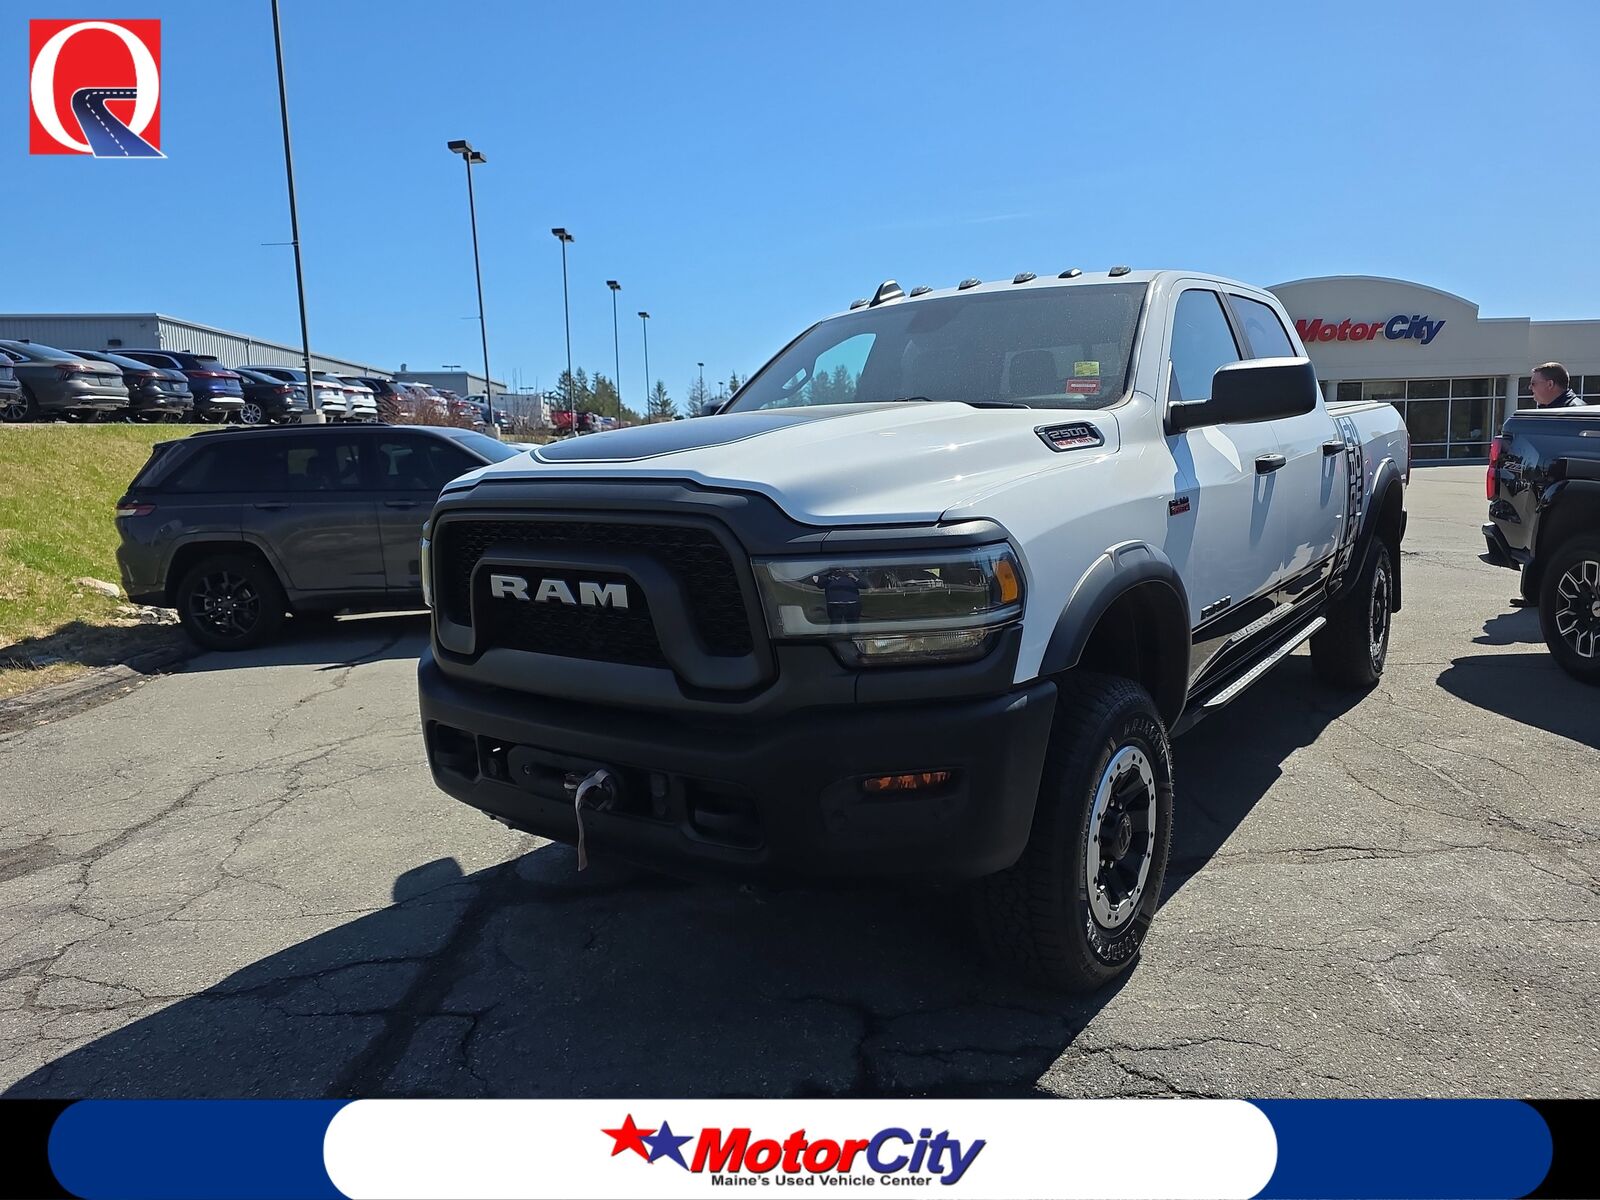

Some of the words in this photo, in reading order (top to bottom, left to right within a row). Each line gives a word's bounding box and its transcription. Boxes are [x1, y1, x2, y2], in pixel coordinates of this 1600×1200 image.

[1295, 315, 1446, 344] MotorCity
[1048, 427, 1089, 439] 2500
[490, 574, 628, 608] RAM
